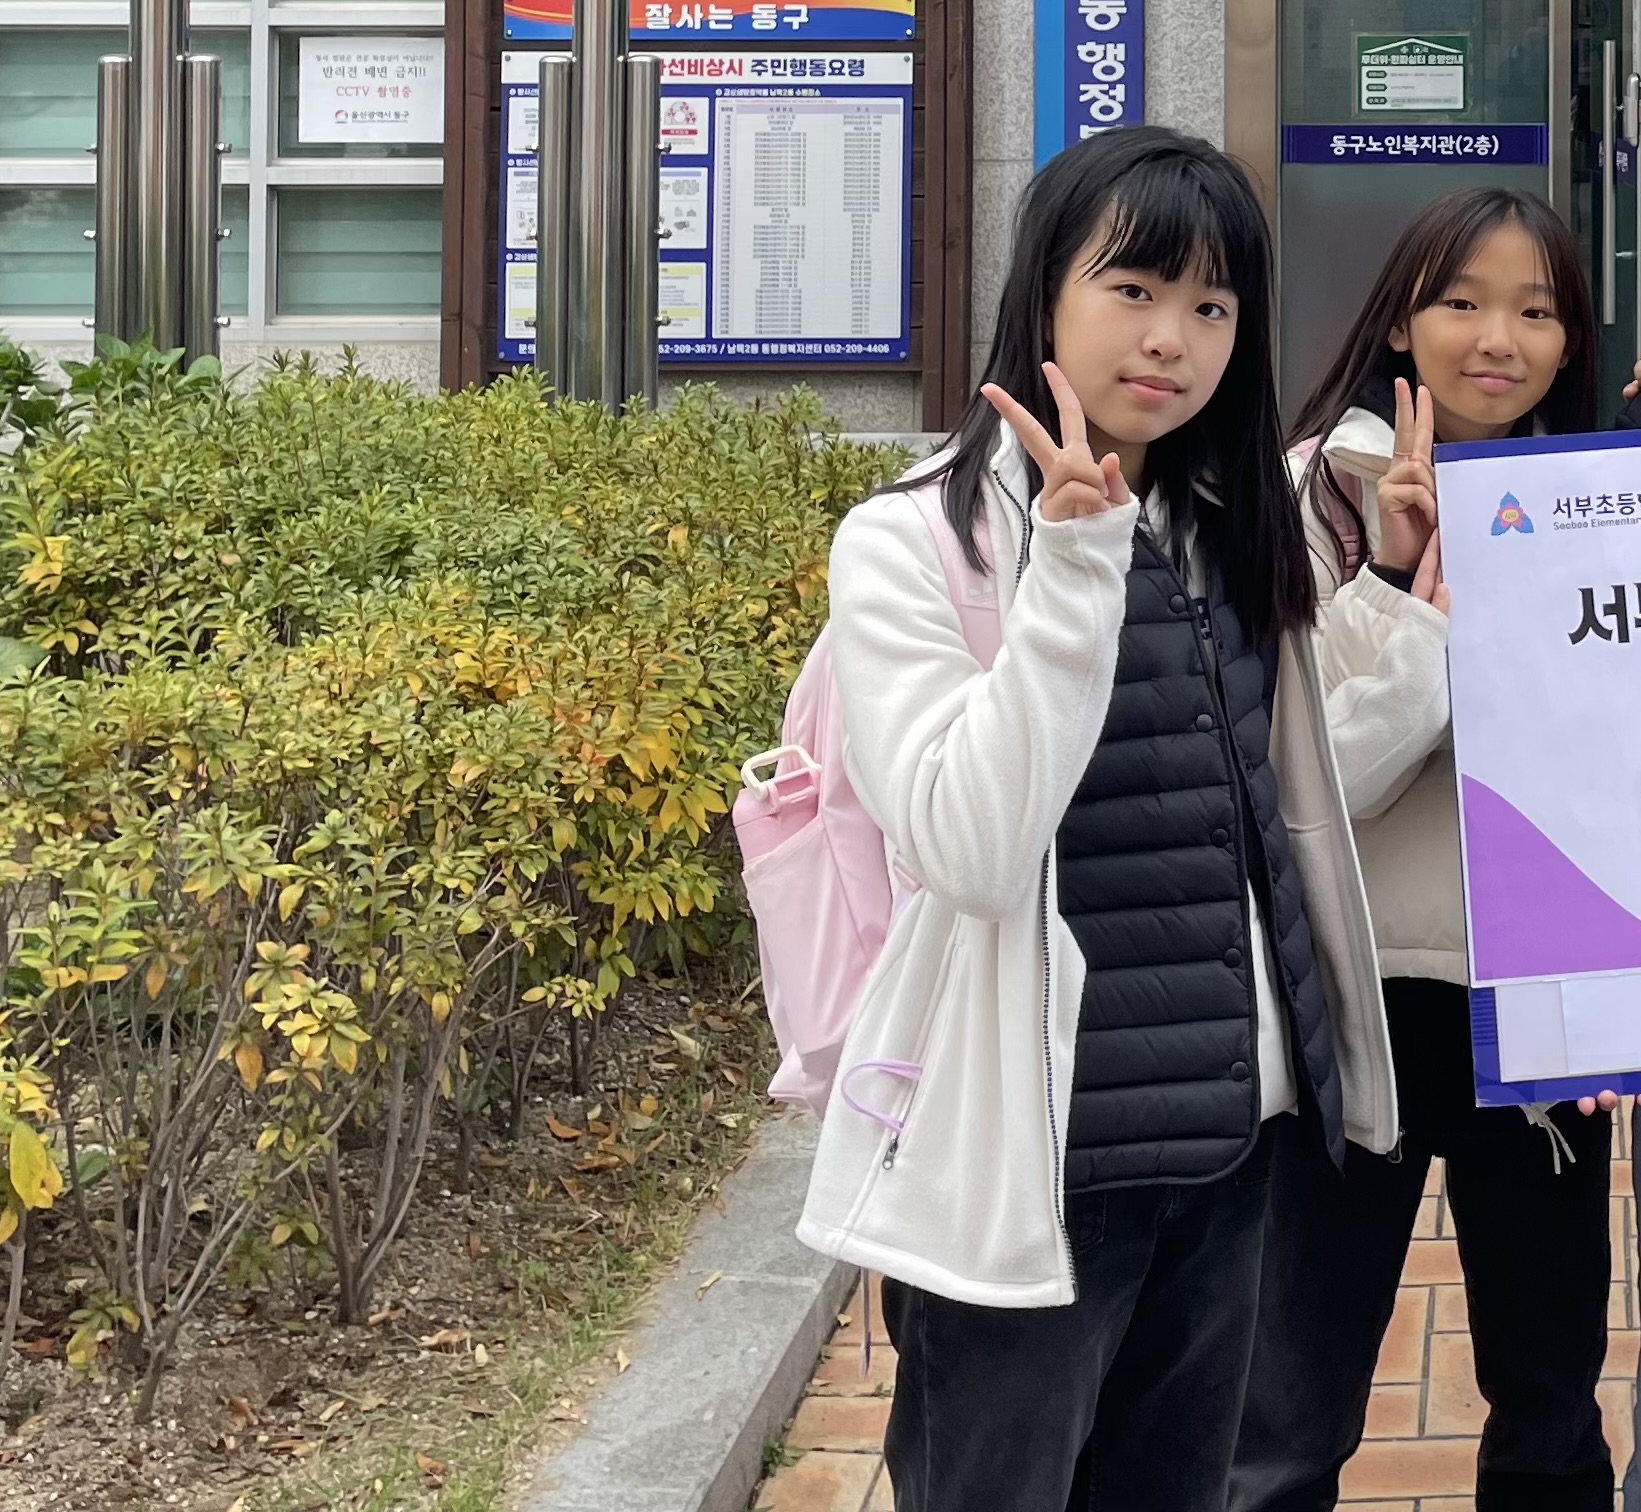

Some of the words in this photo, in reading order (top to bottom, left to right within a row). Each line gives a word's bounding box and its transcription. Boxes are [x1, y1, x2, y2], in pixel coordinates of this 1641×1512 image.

[644, 3, 735, 31] 잘사는
[751, 3, 810, 31] 동구
[750, 58, 866, 78] 주민행동요령
[336, 85, 370, 97] CCTV
[1076, 41, 1127, 143] 행정
[1329, 134, 1500, 156] 동구노인복지관(2층)
[824, 343, 890, 355] 052-209-4406
